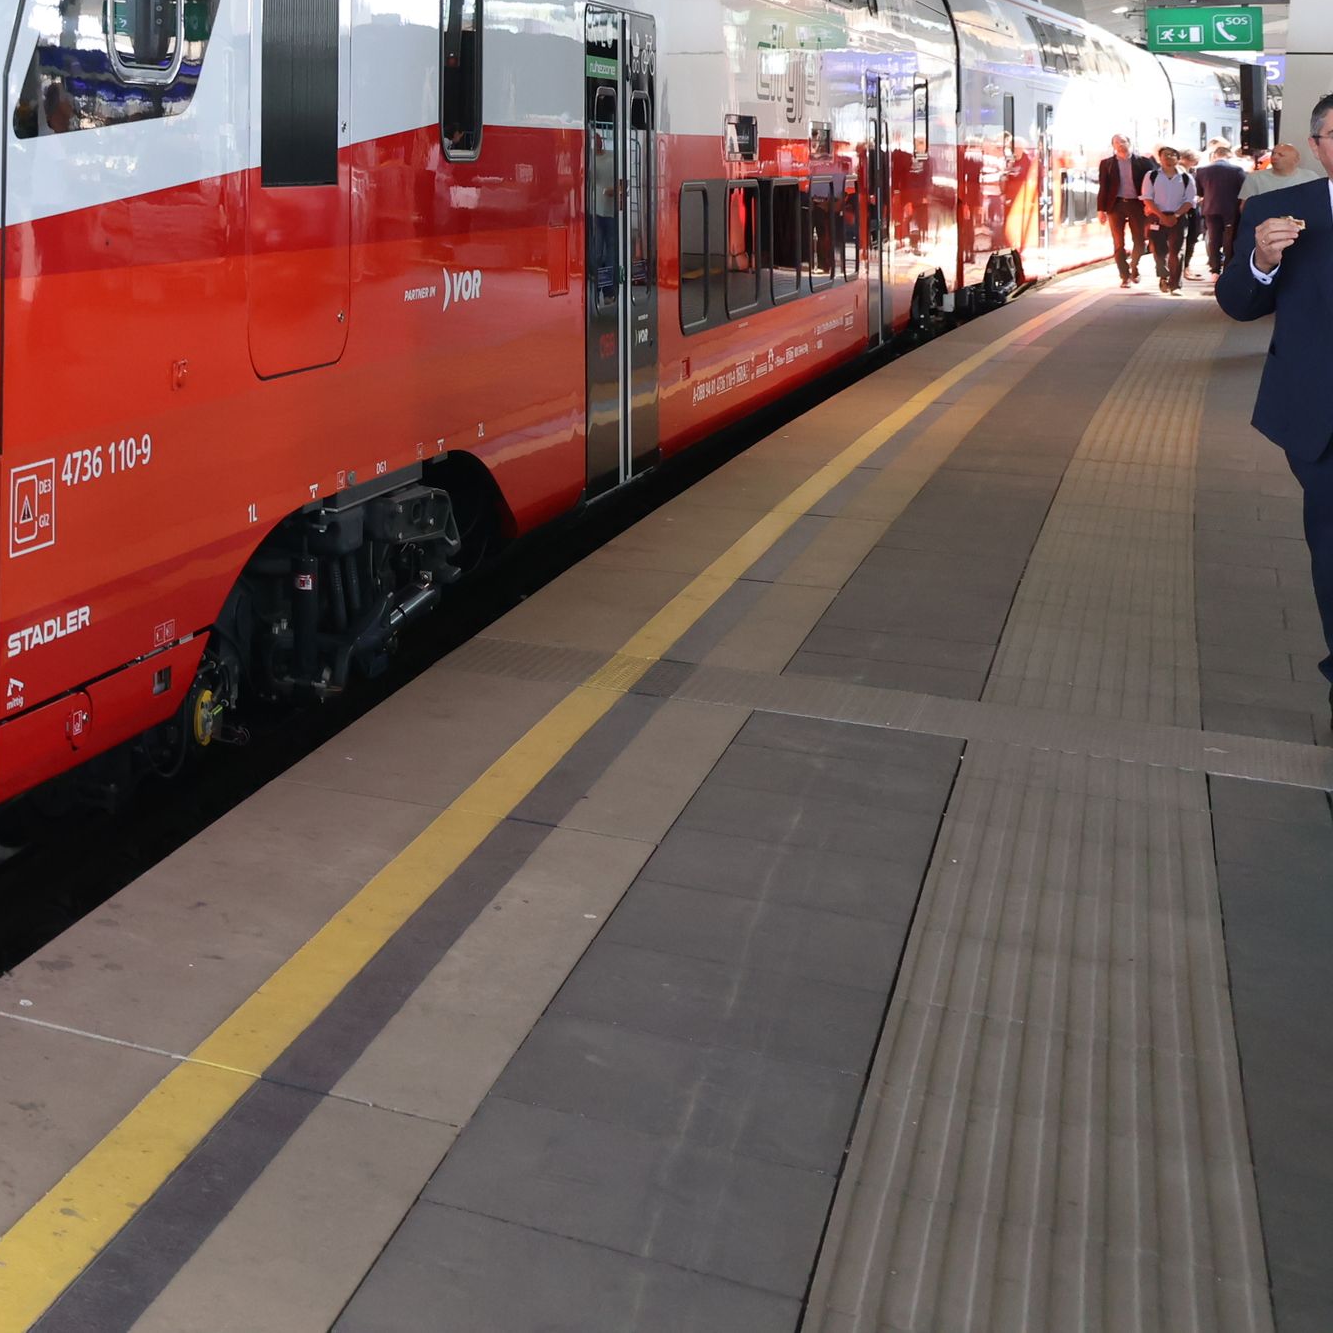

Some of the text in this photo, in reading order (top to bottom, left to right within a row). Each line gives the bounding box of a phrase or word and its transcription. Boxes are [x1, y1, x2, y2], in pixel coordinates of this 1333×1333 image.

[1225, 17, 1248, 25] SOS
[1265, 61, 1280, 80] 5
[404, 287, 429, 301] PARTNER
[453, 269, 482, 302] VOR
[62, 433, 151, 486] 4736 110-9
[39, 479, 51, 494] DE3
[248, 504, 257, 522] 1L
[7, 605, 90, 658] STADLER
[6, 696, 24, 711] mittig
